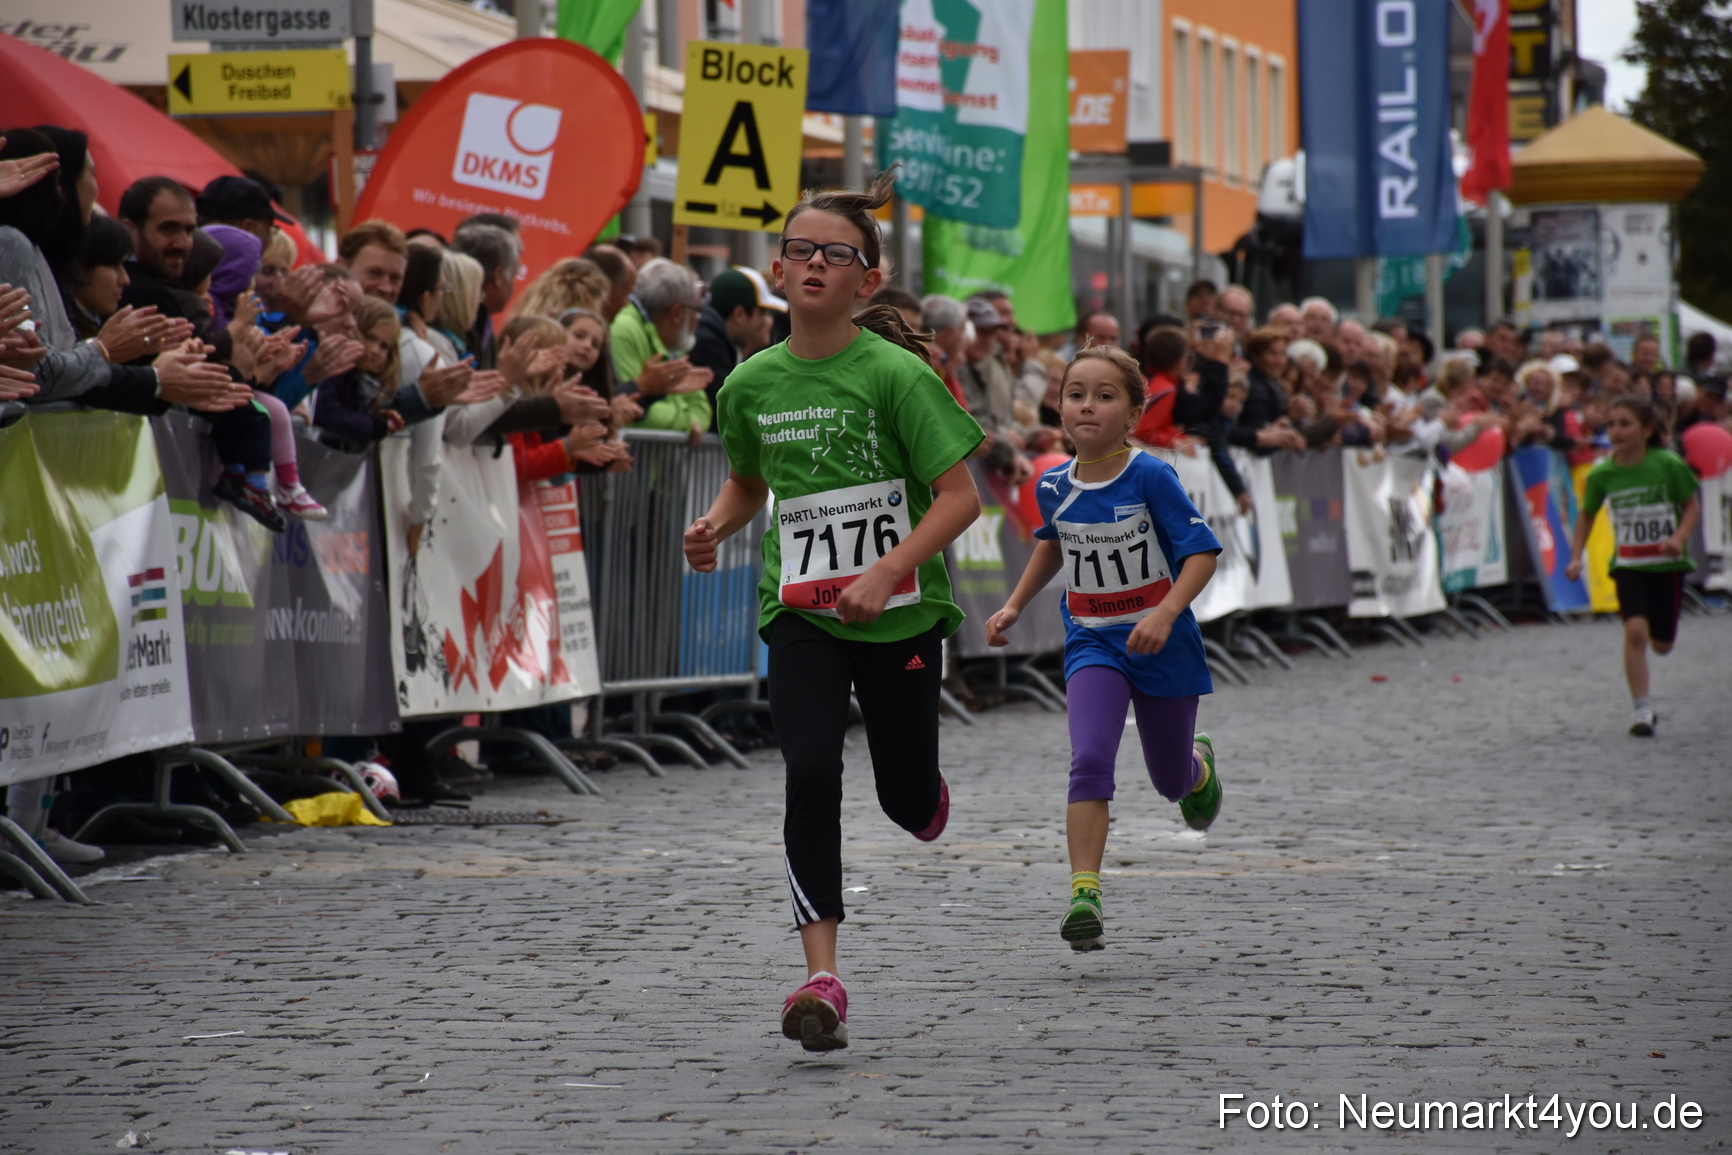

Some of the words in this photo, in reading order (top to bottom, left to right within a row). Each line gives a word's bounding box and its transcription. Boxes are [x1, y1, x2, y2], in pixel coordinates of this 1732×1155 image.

[183, 5, 331, 37] Klostergasse
[221, 64, 296, 81] Duschen
[701, 48, 795, 88] Block
[228, 84, 292, 101] Freibad
[703, 101, 772, 191] A
[461, 152, 542, 189] DKMS
[757, 406, 837, 427] Neumarkter
[761, 424, 820, 445] Stadtlauf
[867, 408, 885, 478] BAMBINI
[780, 508, 818, 526] PARTL
[819, 497, 883, 518] Neumarkt
[793, 513, 900, 576] 7176
[1060, 532, 1084, 544] PARTL
[1085, 529, 1135, 544] Neumarkt
[1622, 519, 1675, 543] 7084
[1068, 539, 1150, 588] 7117
[1088, 595, 1145, 614] Simone
